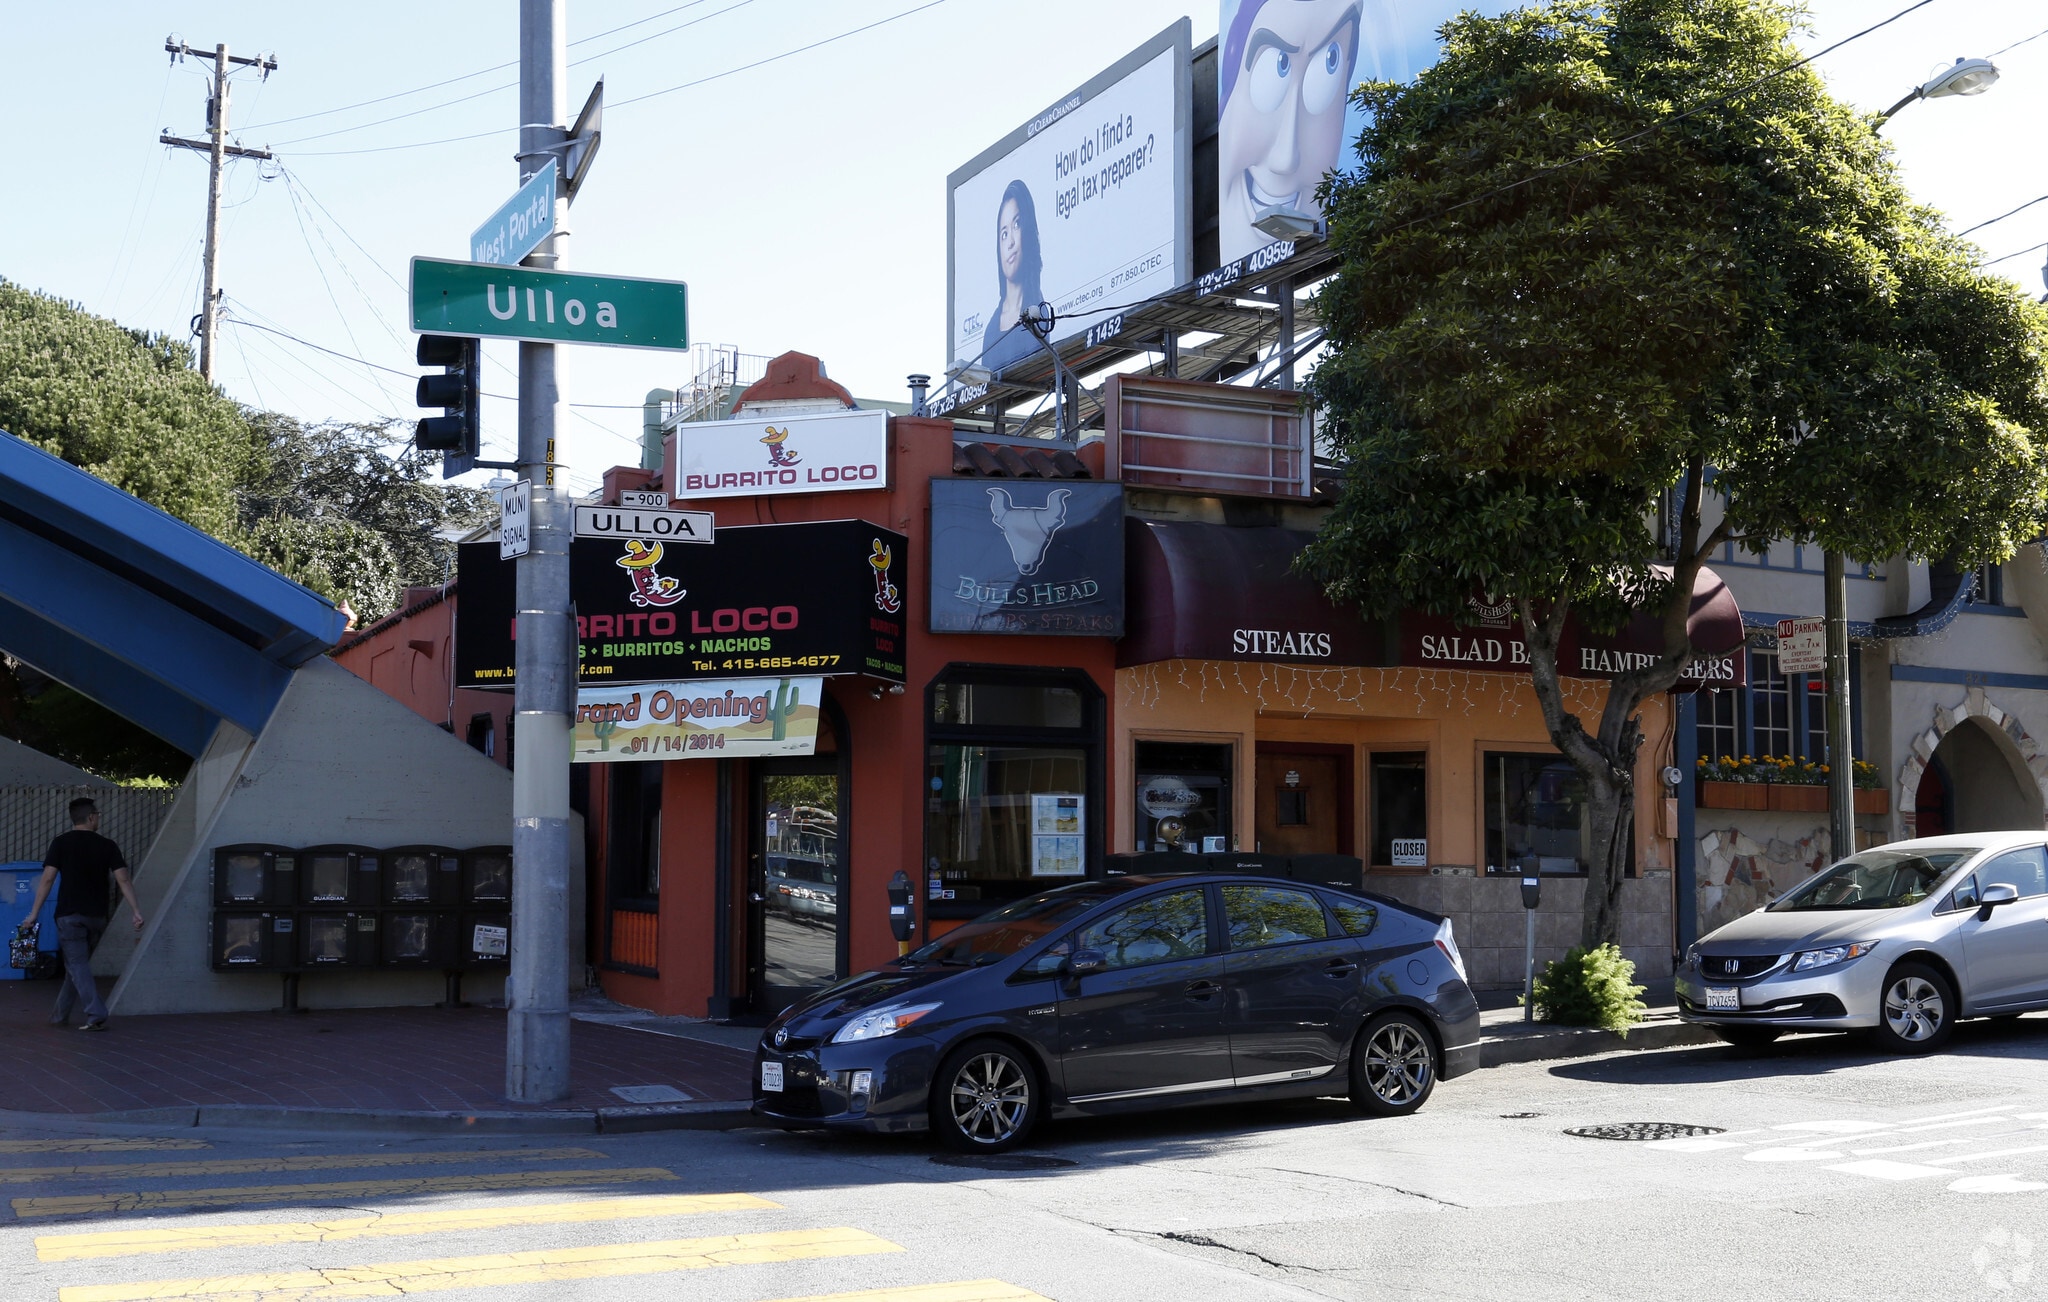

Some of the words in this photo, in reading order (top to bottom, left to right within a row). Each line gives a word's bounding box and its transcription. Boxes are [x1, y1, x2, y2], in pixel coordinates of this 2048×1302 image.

[1055, 148, 1078, 181] How
[1080, 136, 1093, 166] do
[1096, 128, 1100, 156] I
[1102, 113, 1123, 152] find
[1126, 115, 1133, 138] a
[1055, 177, 1079, 219] legal
[1082, 173, 1098, 201] tax
[1101, 133, 1154, 199] preparer?
[476, 224, 505, 263] West
[509, 184, 549, 246] Portal
[1249, 240, 1295, 272] 409592
[1057, 285, 1104, 314] www.ctec.org
[1110, 254, 1162, 288] 877.850.CTEC
[487, 283, 617, 328] Ulloa
[963, 312, 980, 335] CTEC
[1095, 315, 1122, 343] 1452
[959, 383, 988, 405] 409592
[686, 467, 797, 490] BURRITO
[807, 464, 879, 483] LOCO
[505, 493, 526, 517] MUNI
[638, 493, 663, 506] 900
[503, 524, 527, 547] SIGNAL
[591, 512, 696, 537] ULLOA
[511, 611, 677, 641] RITO
[691, 605, 799, 635] LOCO
[869, 616, 900, 638] BURRITO
[1041, 613, 1114, 631] STEAKS
[1779, 621, 1792, 636] NO
[1794, 621, 1823, 634] PARKING
[602, 641, 684, 658] BURRITOS
[701, 637, 772, 653] NACHOS
[875, 636, 895, 653] LOCO
[1233, 628, 1332, 657] STEAKS
[1421, 634, 1502, 663] SALAD
[692, 660, 717, 671] Tel.
[722, 655, 841, 671] 415-665-4677
[866, 656, 881, 668] TACOS
[884, 661, 903, 674] NACHOS
[1580, 647, 1735, 680] HAMBGERS
[577, 692, 642, 723] rand
[649, 689, 769, 727] Opening
[1393, 842, 1425, 856] CLOSED
[359, 919, 373, 927] FREE
